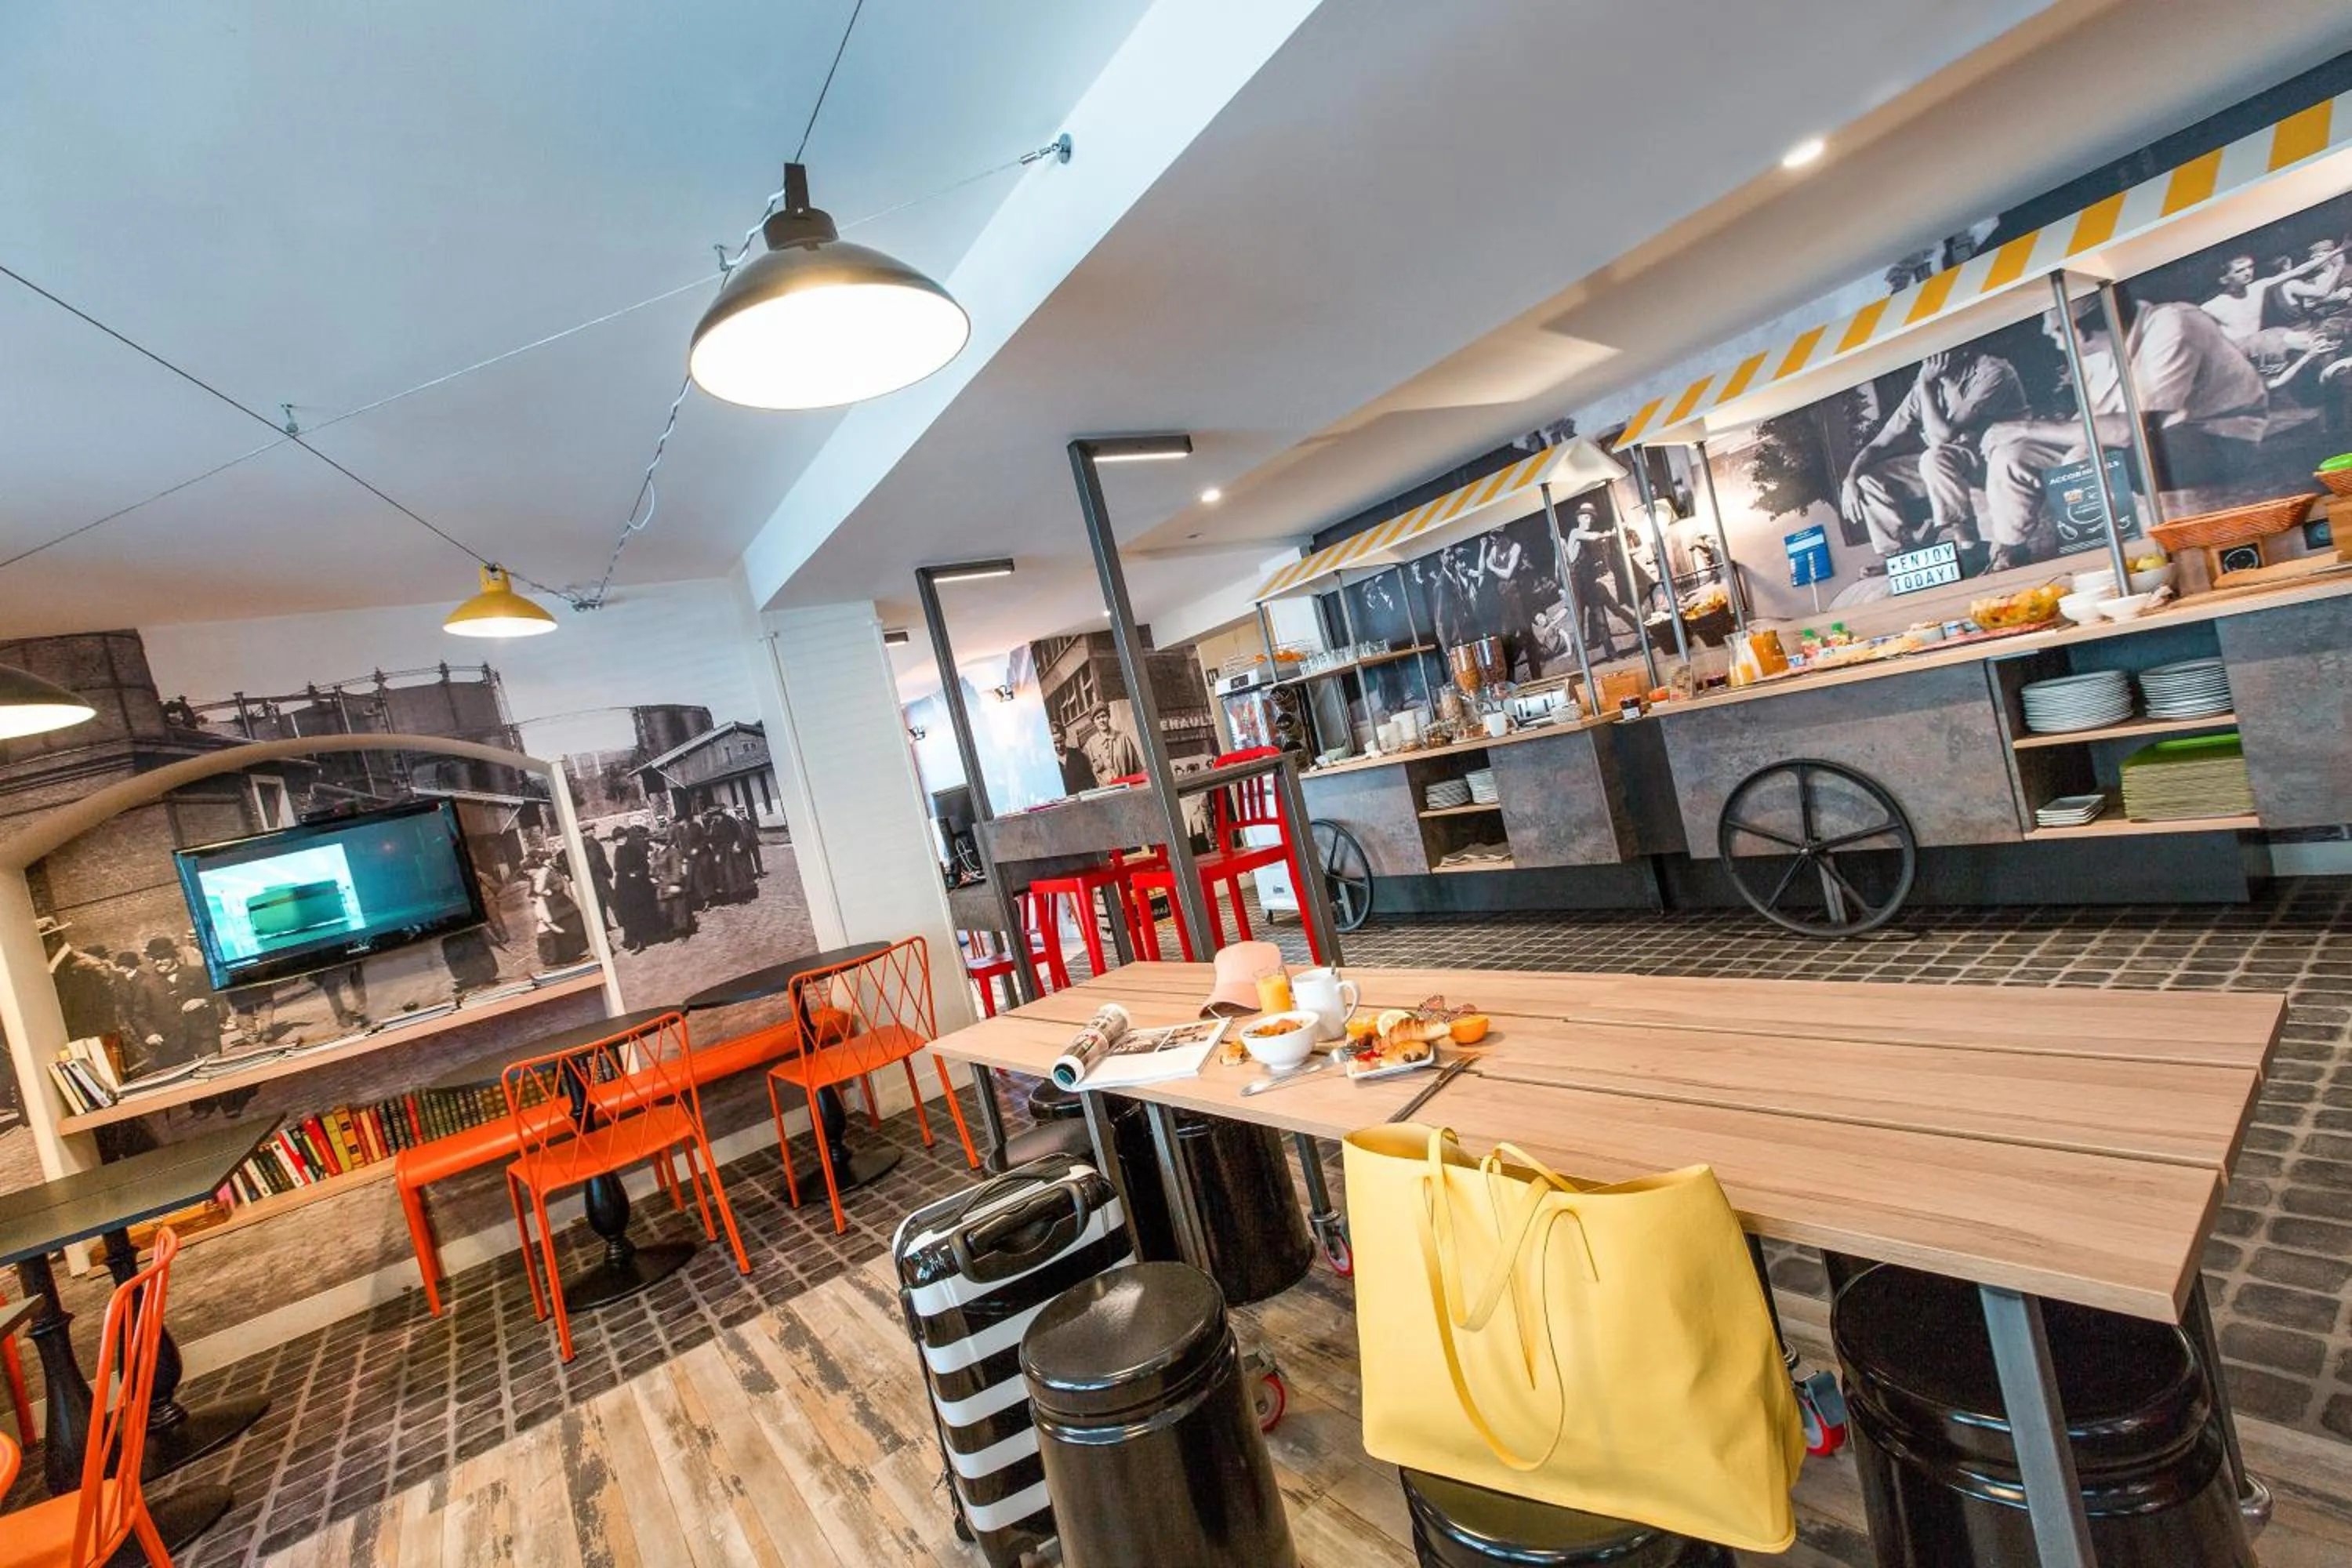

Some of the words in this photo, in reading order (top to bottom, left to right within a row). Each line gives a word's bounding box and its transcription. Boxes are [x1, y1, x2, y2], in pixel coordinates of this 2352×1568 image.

[1900, 545, 1952, 570] ENJOY
[1893, 564, 1956, 591] TODAY!
[1160, 713, 1213, 731] ENAULT
